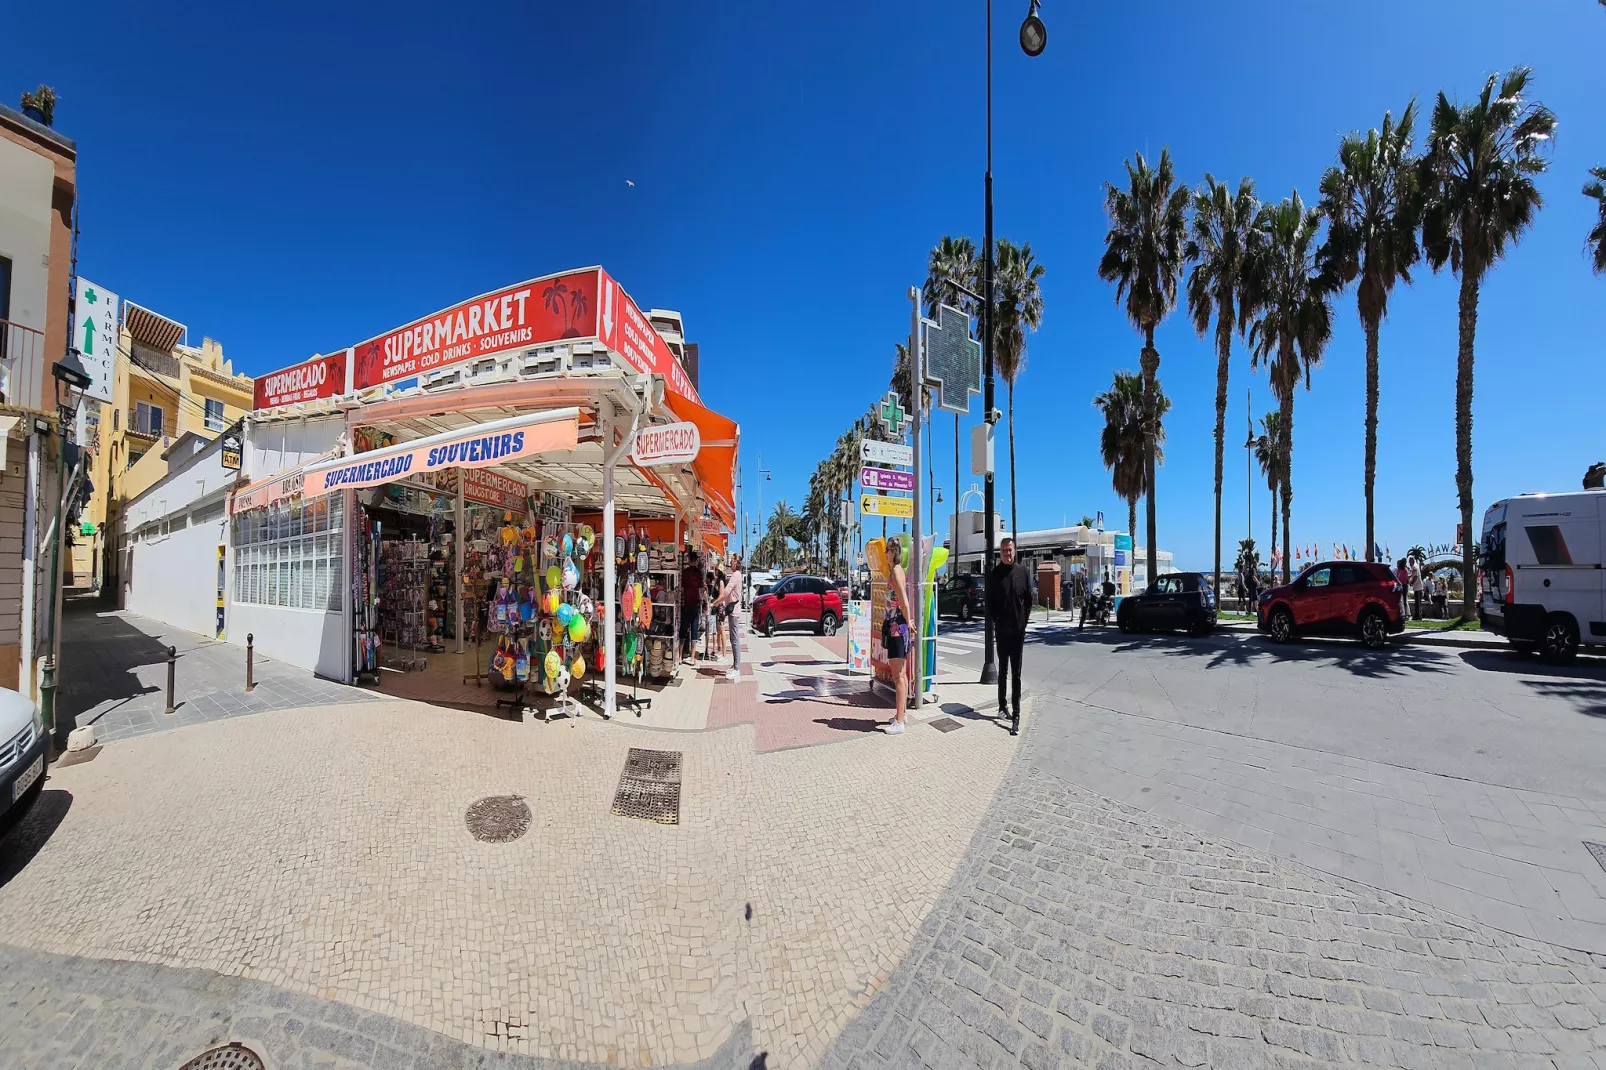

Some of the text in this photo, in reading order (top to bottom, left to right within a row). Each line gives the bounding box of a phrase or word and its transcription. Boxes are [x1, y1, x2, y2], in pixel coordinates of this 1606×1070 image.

[384, 289, 531, 366] SUPERMARKET
[624, 322, 638, 345] COLD
[626, 300, 654, 348] NEWSPAPER
[100, 297, 114, 395] FARMACIA
[382, 326, 532, 380] NEWSPAPER COLD DRINKS SOUVENIRS
[264, 362, 326, 398] SUPERMERCADO
[427, 432, 524, 466] SOUVENIRS
[636, 428, 694, 455] SUPERMERCADO
[224, 455, 239, 465] ATM
[324, 454, 413, 489] SUPERMERCADO
[464, 468, 526, 498] SUPERMERCADO
[465, 483, 500, 502] DRUGSTORE
[1428, 543, 1463, 557] HAWAI
